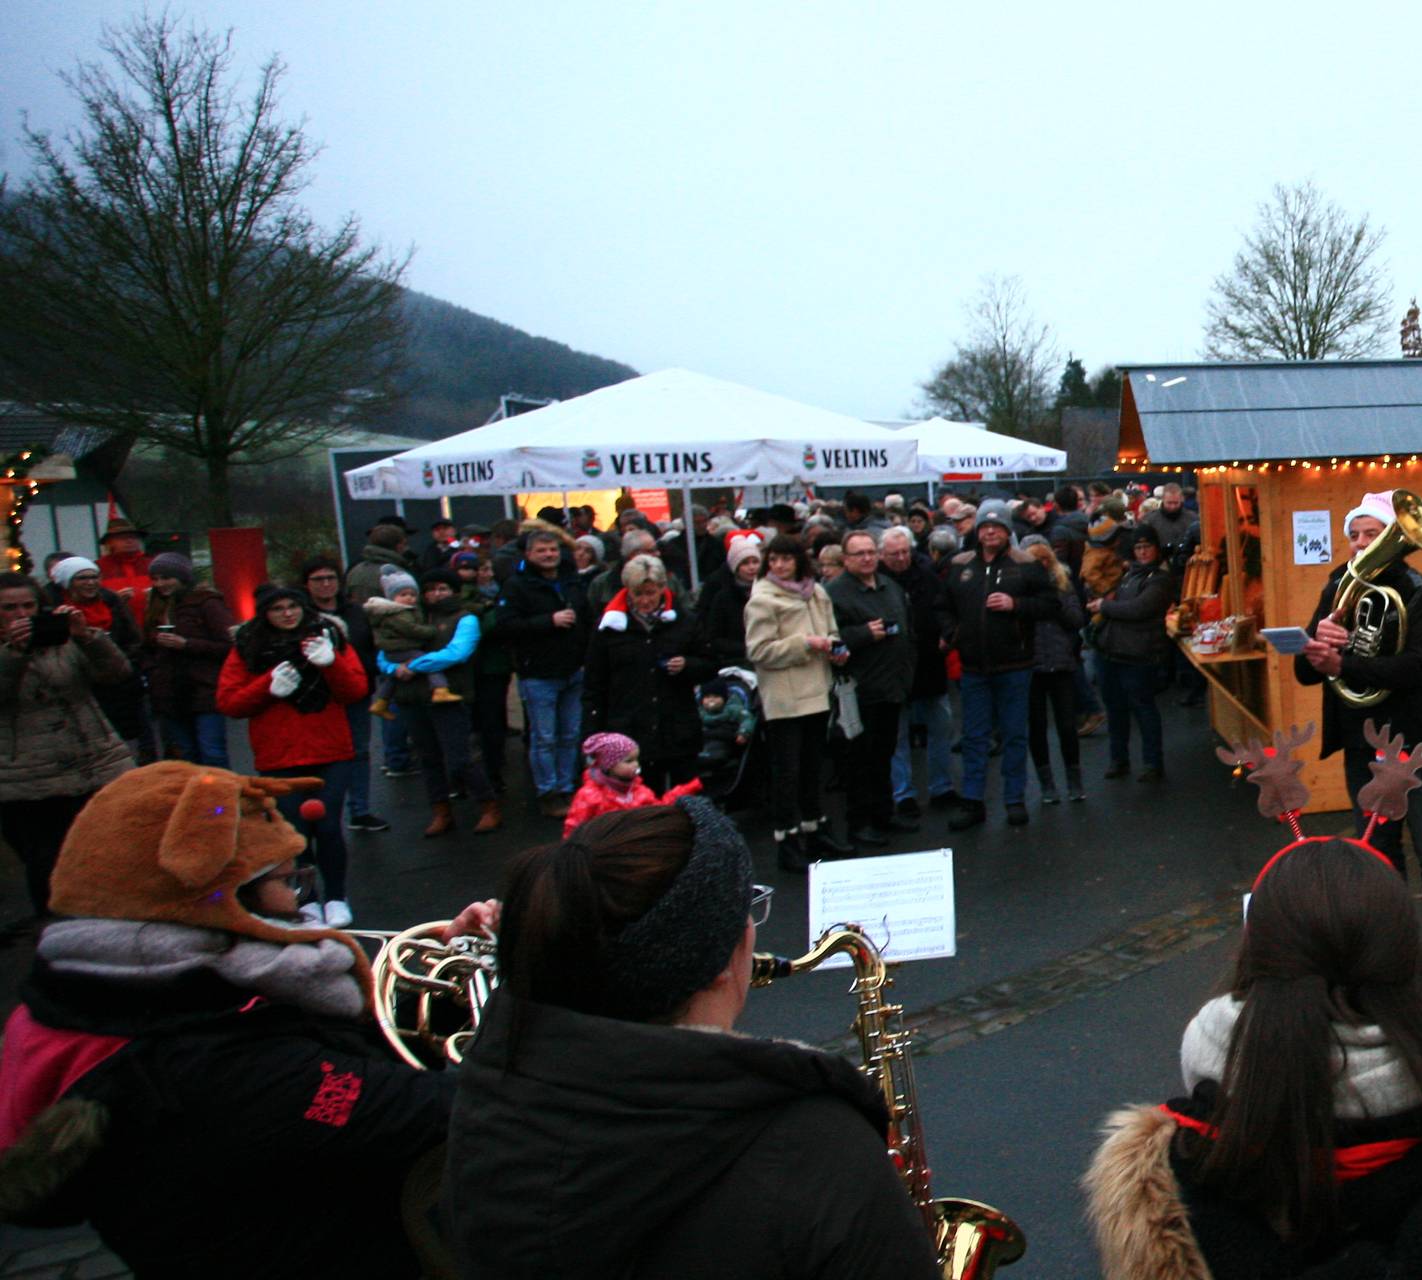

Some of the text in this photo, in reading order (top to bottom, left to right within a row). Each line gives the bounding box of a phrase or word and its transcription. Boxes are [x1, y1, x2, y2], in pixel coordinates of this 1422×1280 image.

[610, 452, 713, 475] VELTINS
[822, 449, 888, 468] VELTINS
[959, 456, 1004, 468] VELTINS
[438, 460, 494, 485] VELTINS
